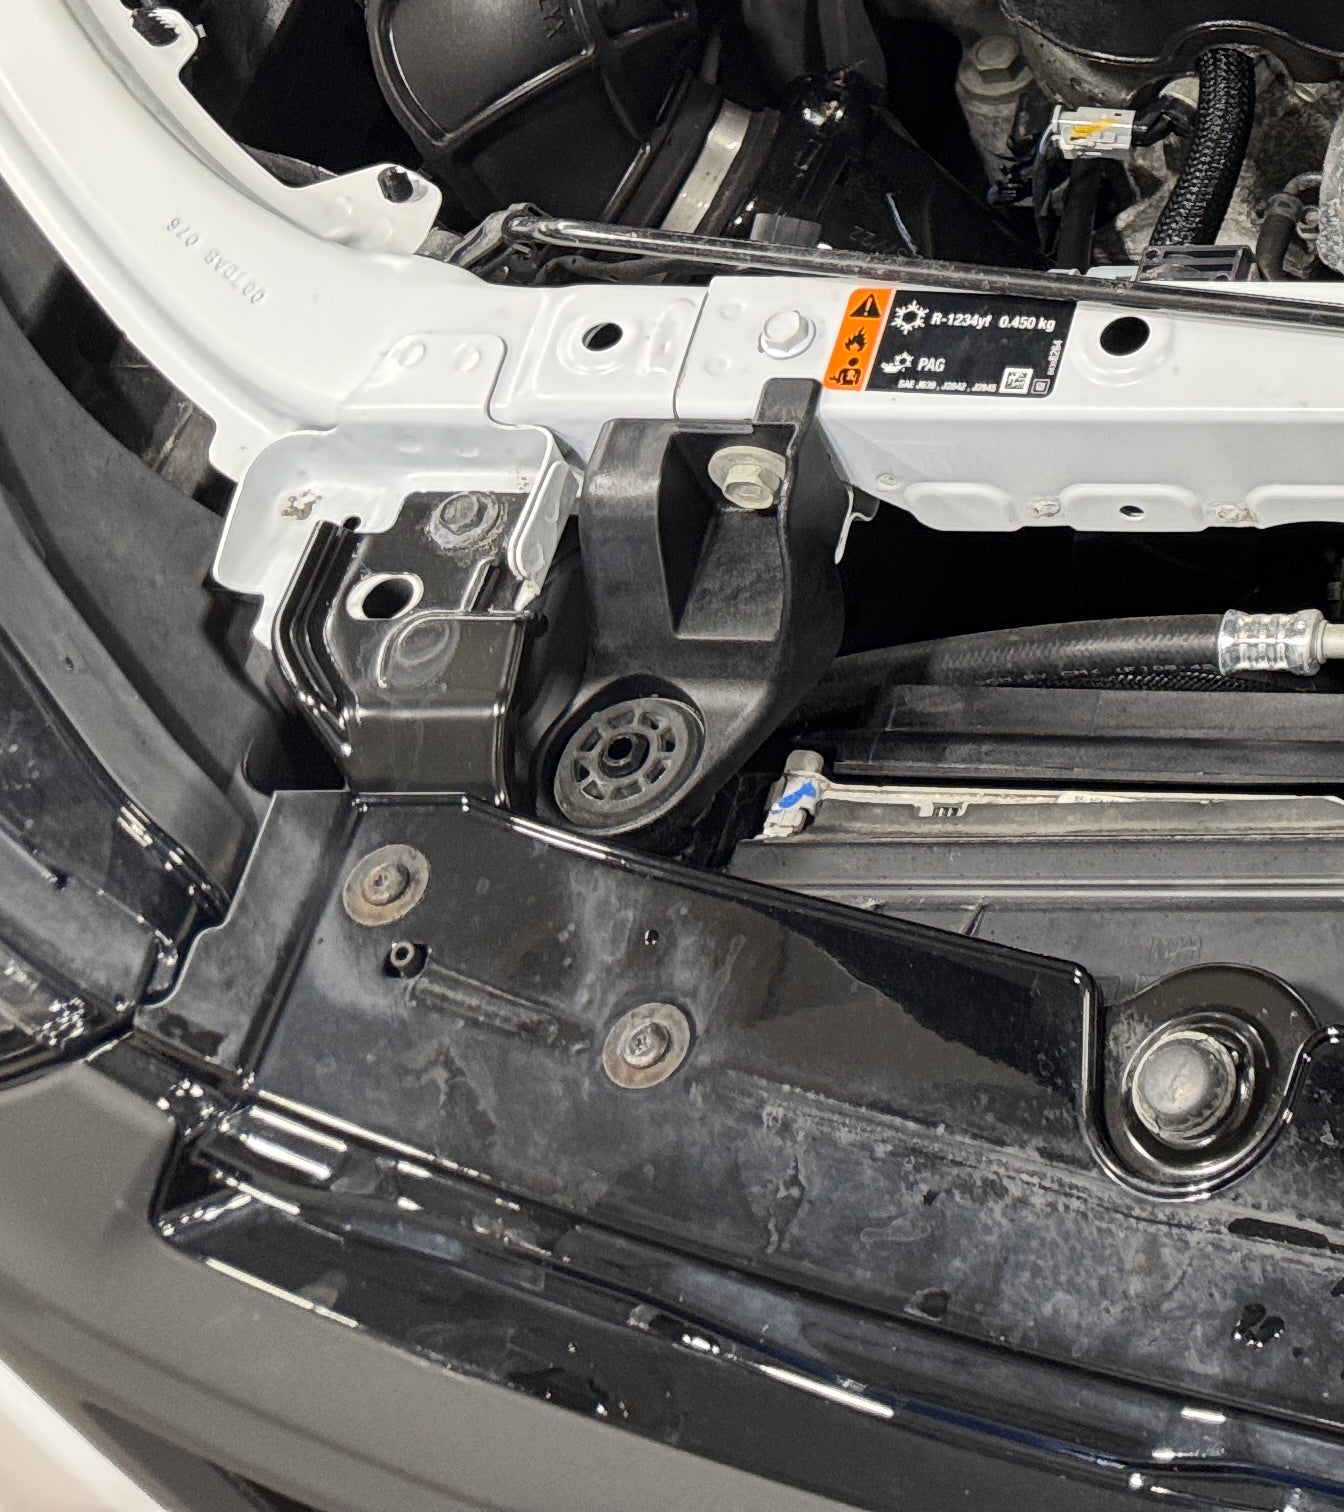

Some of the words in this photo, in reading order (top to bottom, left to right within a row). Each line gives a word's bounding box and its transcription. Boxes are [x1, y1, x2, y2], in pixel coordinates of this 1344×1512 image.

[931, 313, 992, 329] R-1234yf
[998, 315, 1036, 330] 0.450
[1038, 317, 1056, 333] kg
[917, 357, 946, 373] PAG
